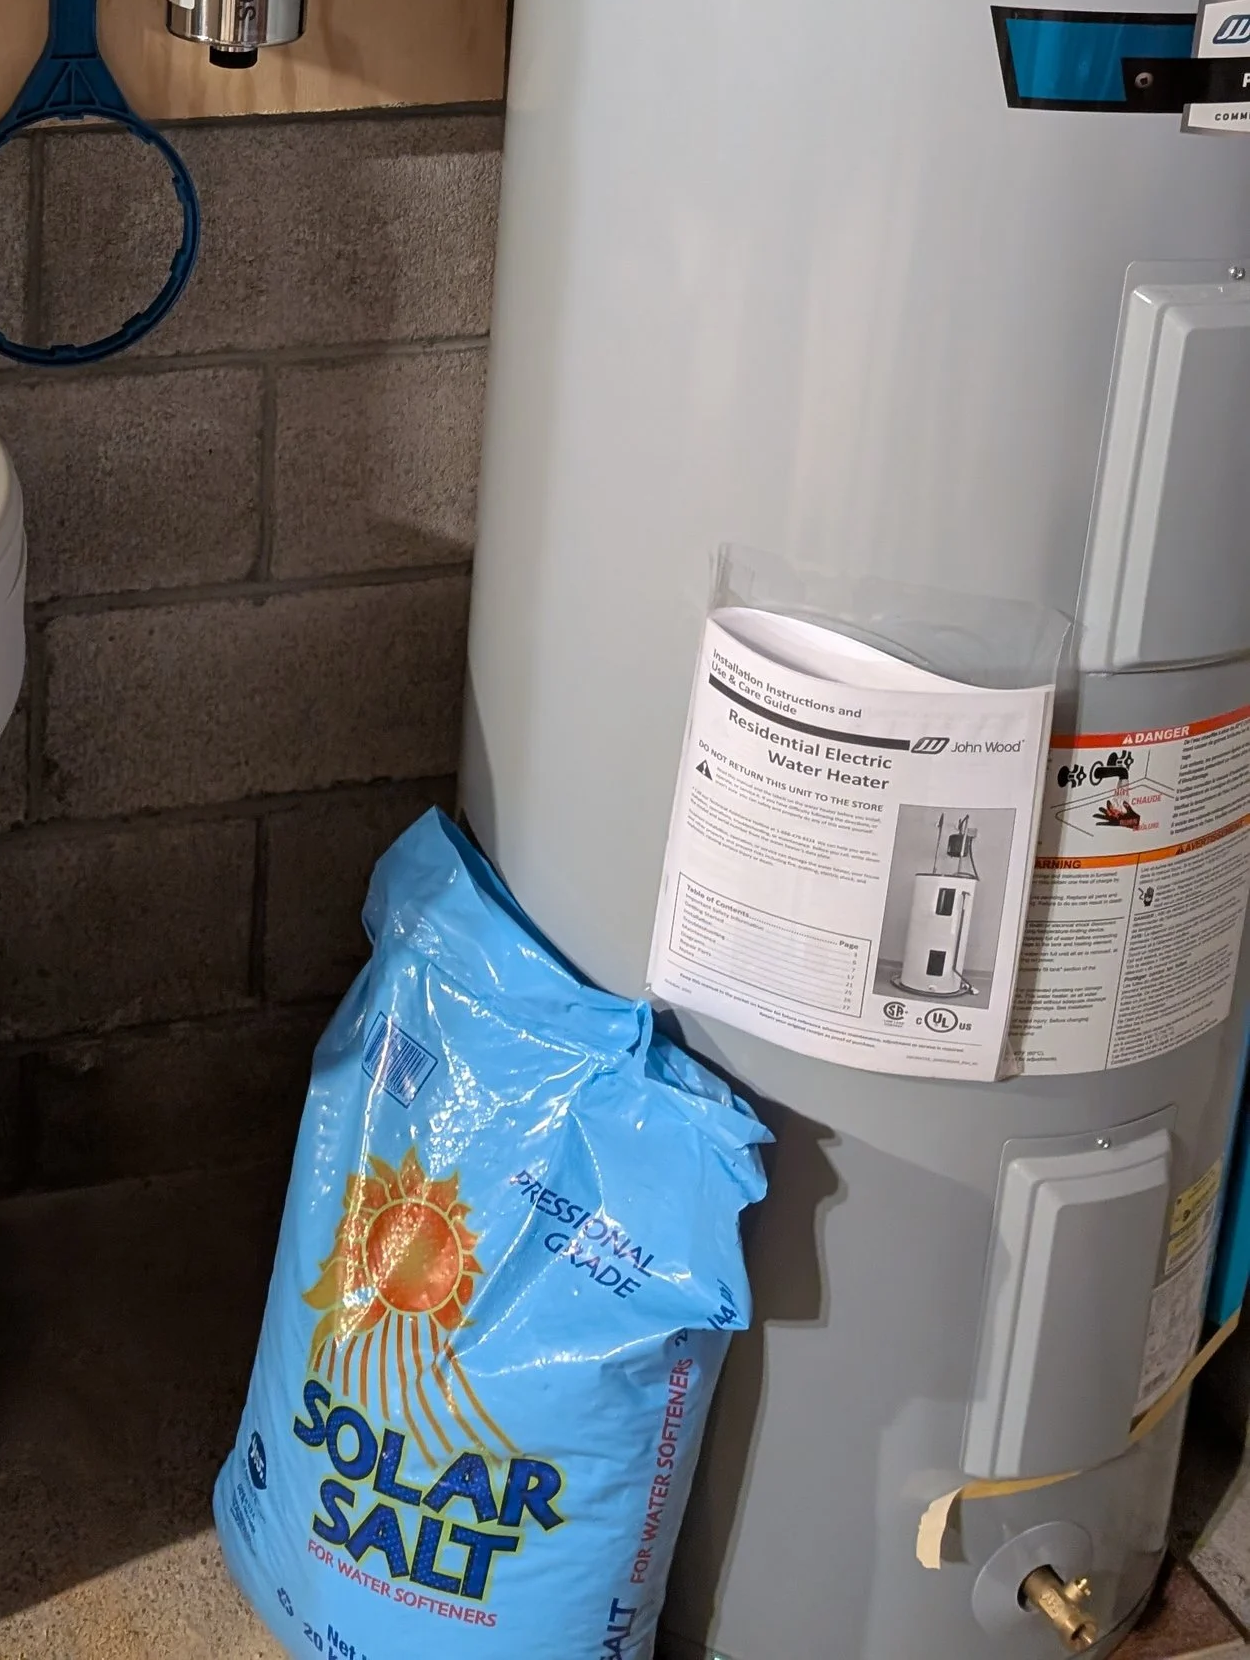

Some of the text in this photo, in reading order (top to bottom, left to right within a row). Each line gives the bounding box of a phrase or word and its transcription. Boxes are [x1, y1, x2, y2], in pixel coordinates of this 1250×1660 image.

[711, 660, 798, 716] Use & Care Guide
[713, 648, 862, 719] Installation Instructions and
[728, 707, 892, 770] Residential Electric
[950, 740, 1021, 754] John Wood
[1134, 725, 1190, 744] DANGER
[698, 739, 884, 813] DO NOT RETURN THIS UNIT TO THE STORE
[767, 749, 890, 790] Water Heater
[1131, 794, 1162, 806] CHAUDE
[1034, 859, 1082, 870] ARNING
[686, 883, 859, 951] Table of Contents Page
[932, 1012, 950, 1029] UL
[544, 1232, 641, 1299] GRADE
[656, 1357, 695, 1471] SOFTENERS
[292, 1378, 567, 1530] SOLAR
[312, 1478, 523, 1600] SALT
[641, 1474, 673, 1546] WATER
[307, 1539, 498, 1628] FOR WATER SOFTENERS
[629, 1549, 653, 1585] FOR
[303, 1621, 324, 1653] 20
[327, 1623, 357, 1659] Net
